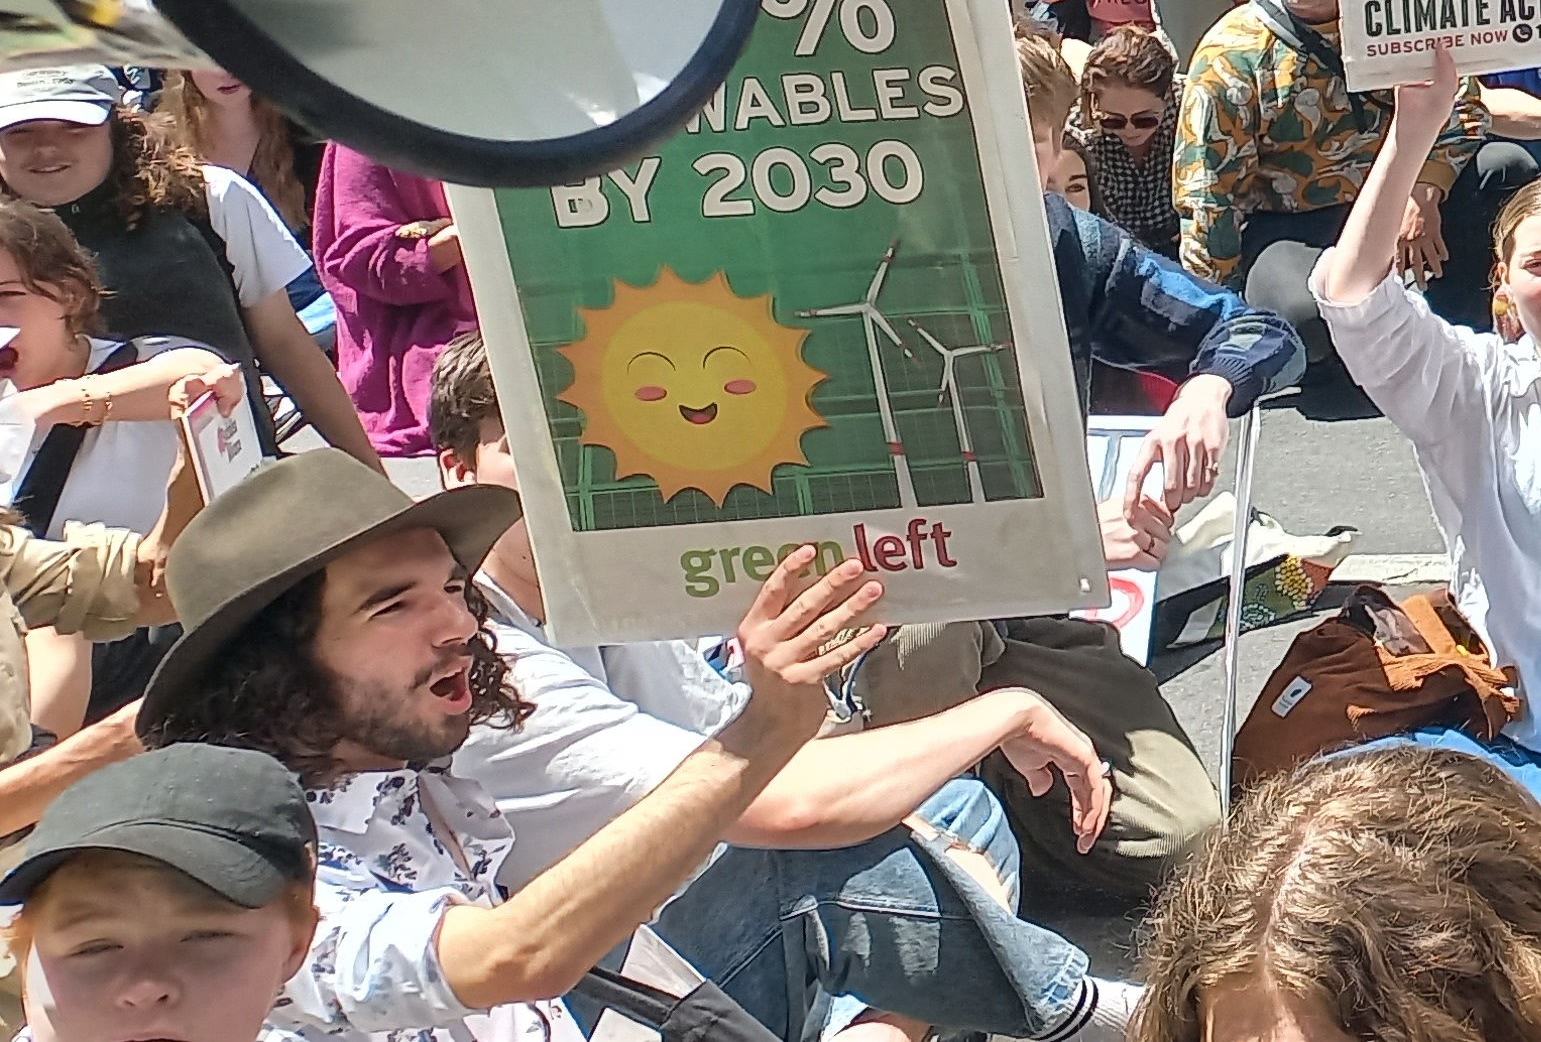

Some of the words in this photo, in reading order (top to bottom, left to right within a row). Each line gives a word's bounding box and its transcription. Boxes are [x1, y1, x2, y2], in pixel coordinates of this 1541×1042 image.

[1470, 27, 1509, 45] NOW
[550, 155, 664, 229] BY
[692, 138, 925, 219] 2030
[680, 532, 846, 599] green
[853, 519, 958, 575] left
